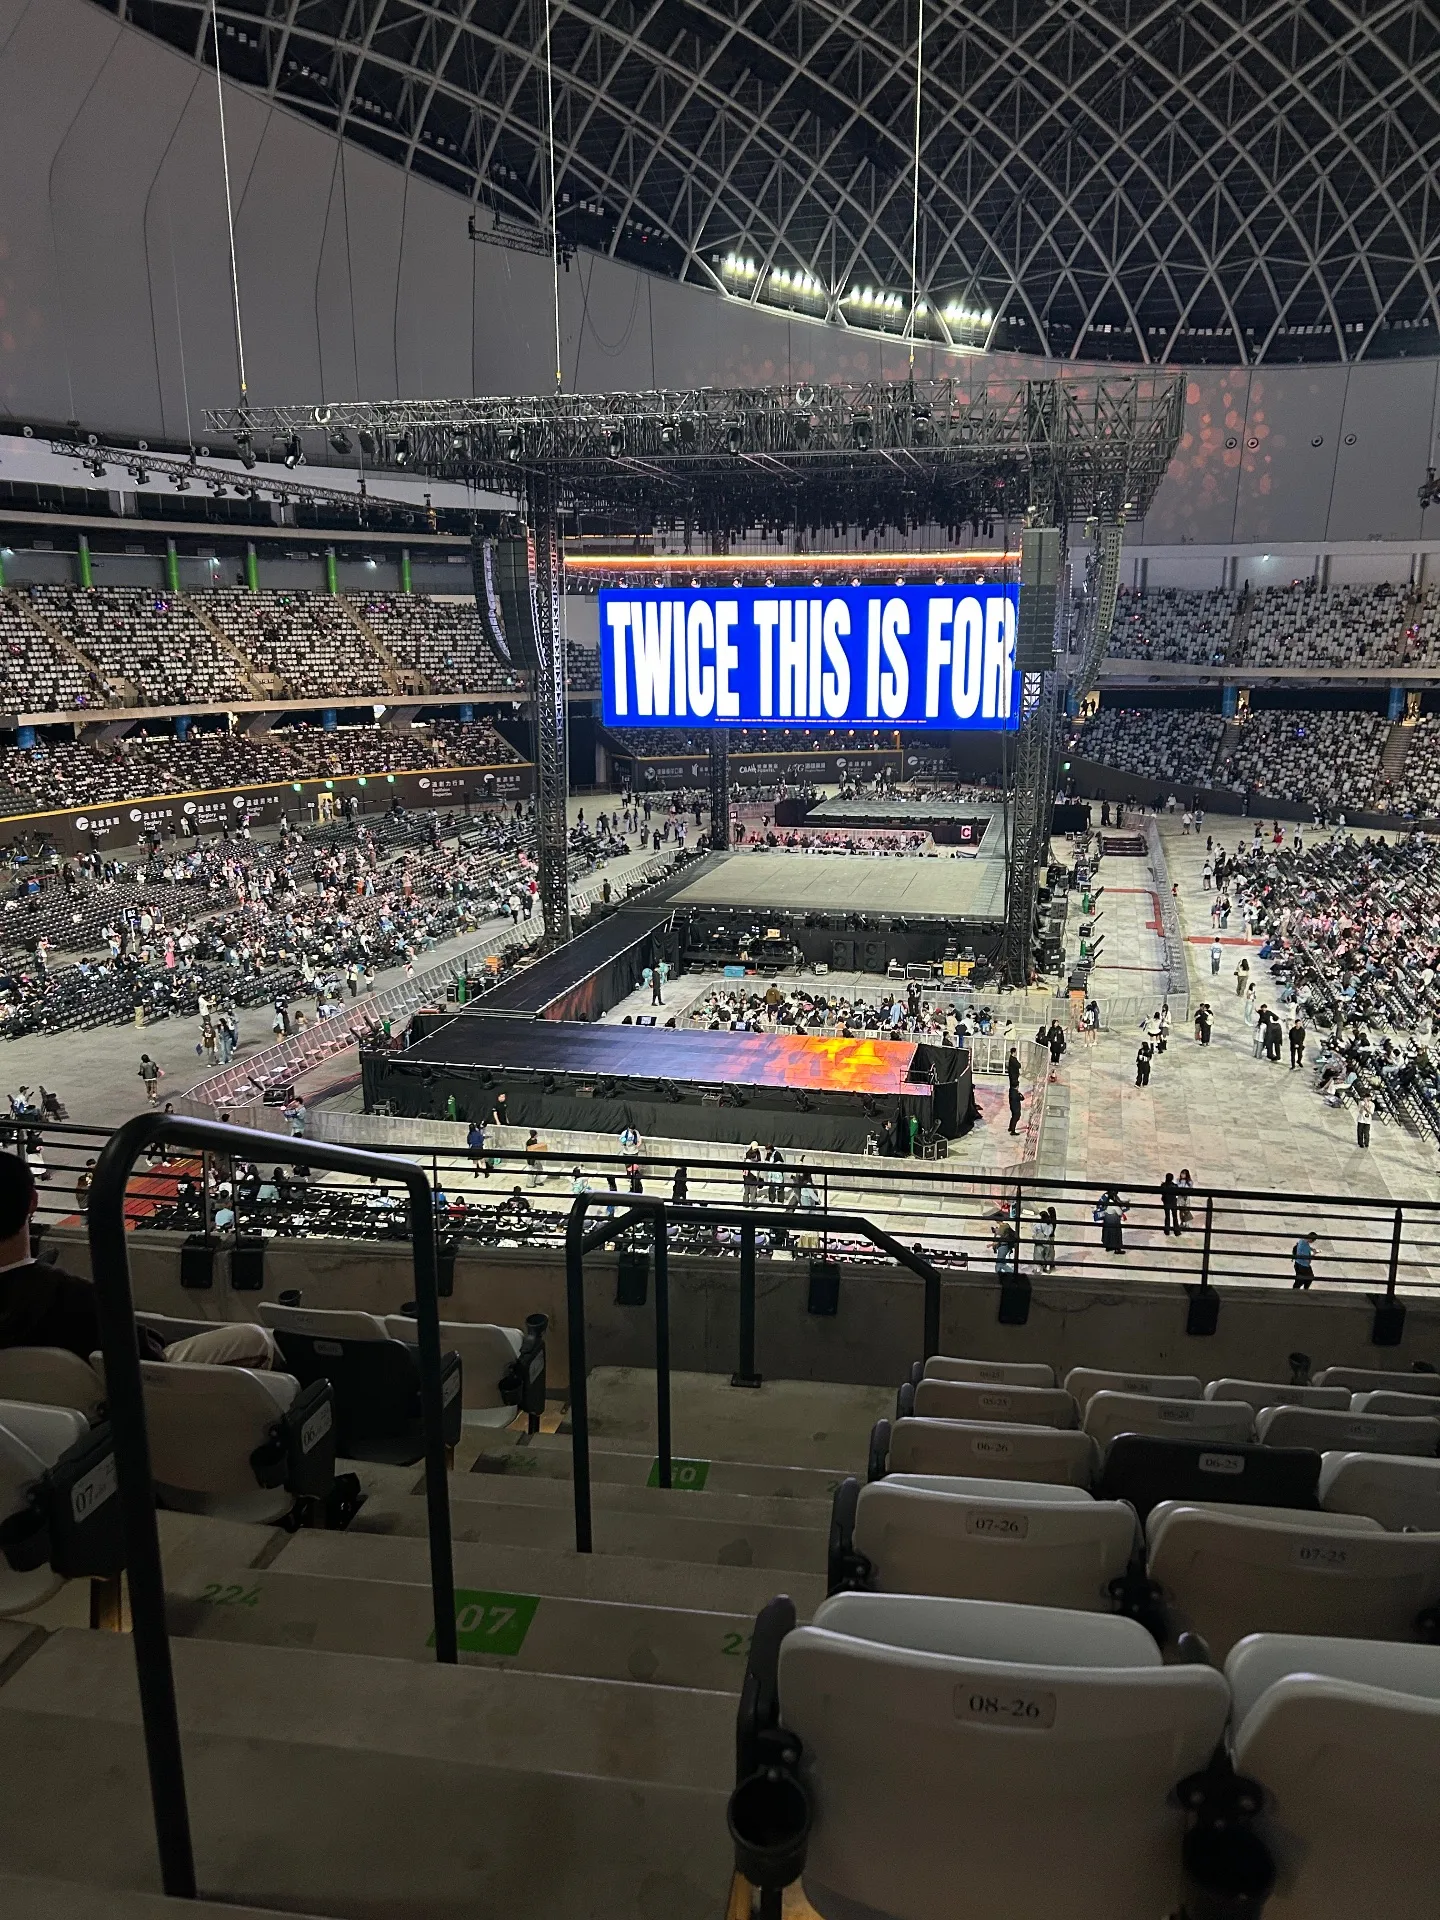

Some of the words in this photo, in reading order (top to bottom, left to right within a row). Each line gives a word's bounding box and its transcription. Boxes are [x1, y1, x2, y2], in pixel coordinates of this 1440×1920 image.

[607, 600, 740, 717] TWICE
[754, 598, 851, 718] THIS
[866, 597, 910, 718] IS
[925, 596, 1015, 718] FOR
[963, 828, 970, 837] C
[75, 1482, 94, 1513] 07
[976, 1518, 1020, 1533] 07-26
[1300, 1547, 1347, 1564] 07-25
[196, 1583, 262, 1607] 224
[455, 1603, 517, 1635] 07
[969, 1695, 1040, 1719] 08-26
